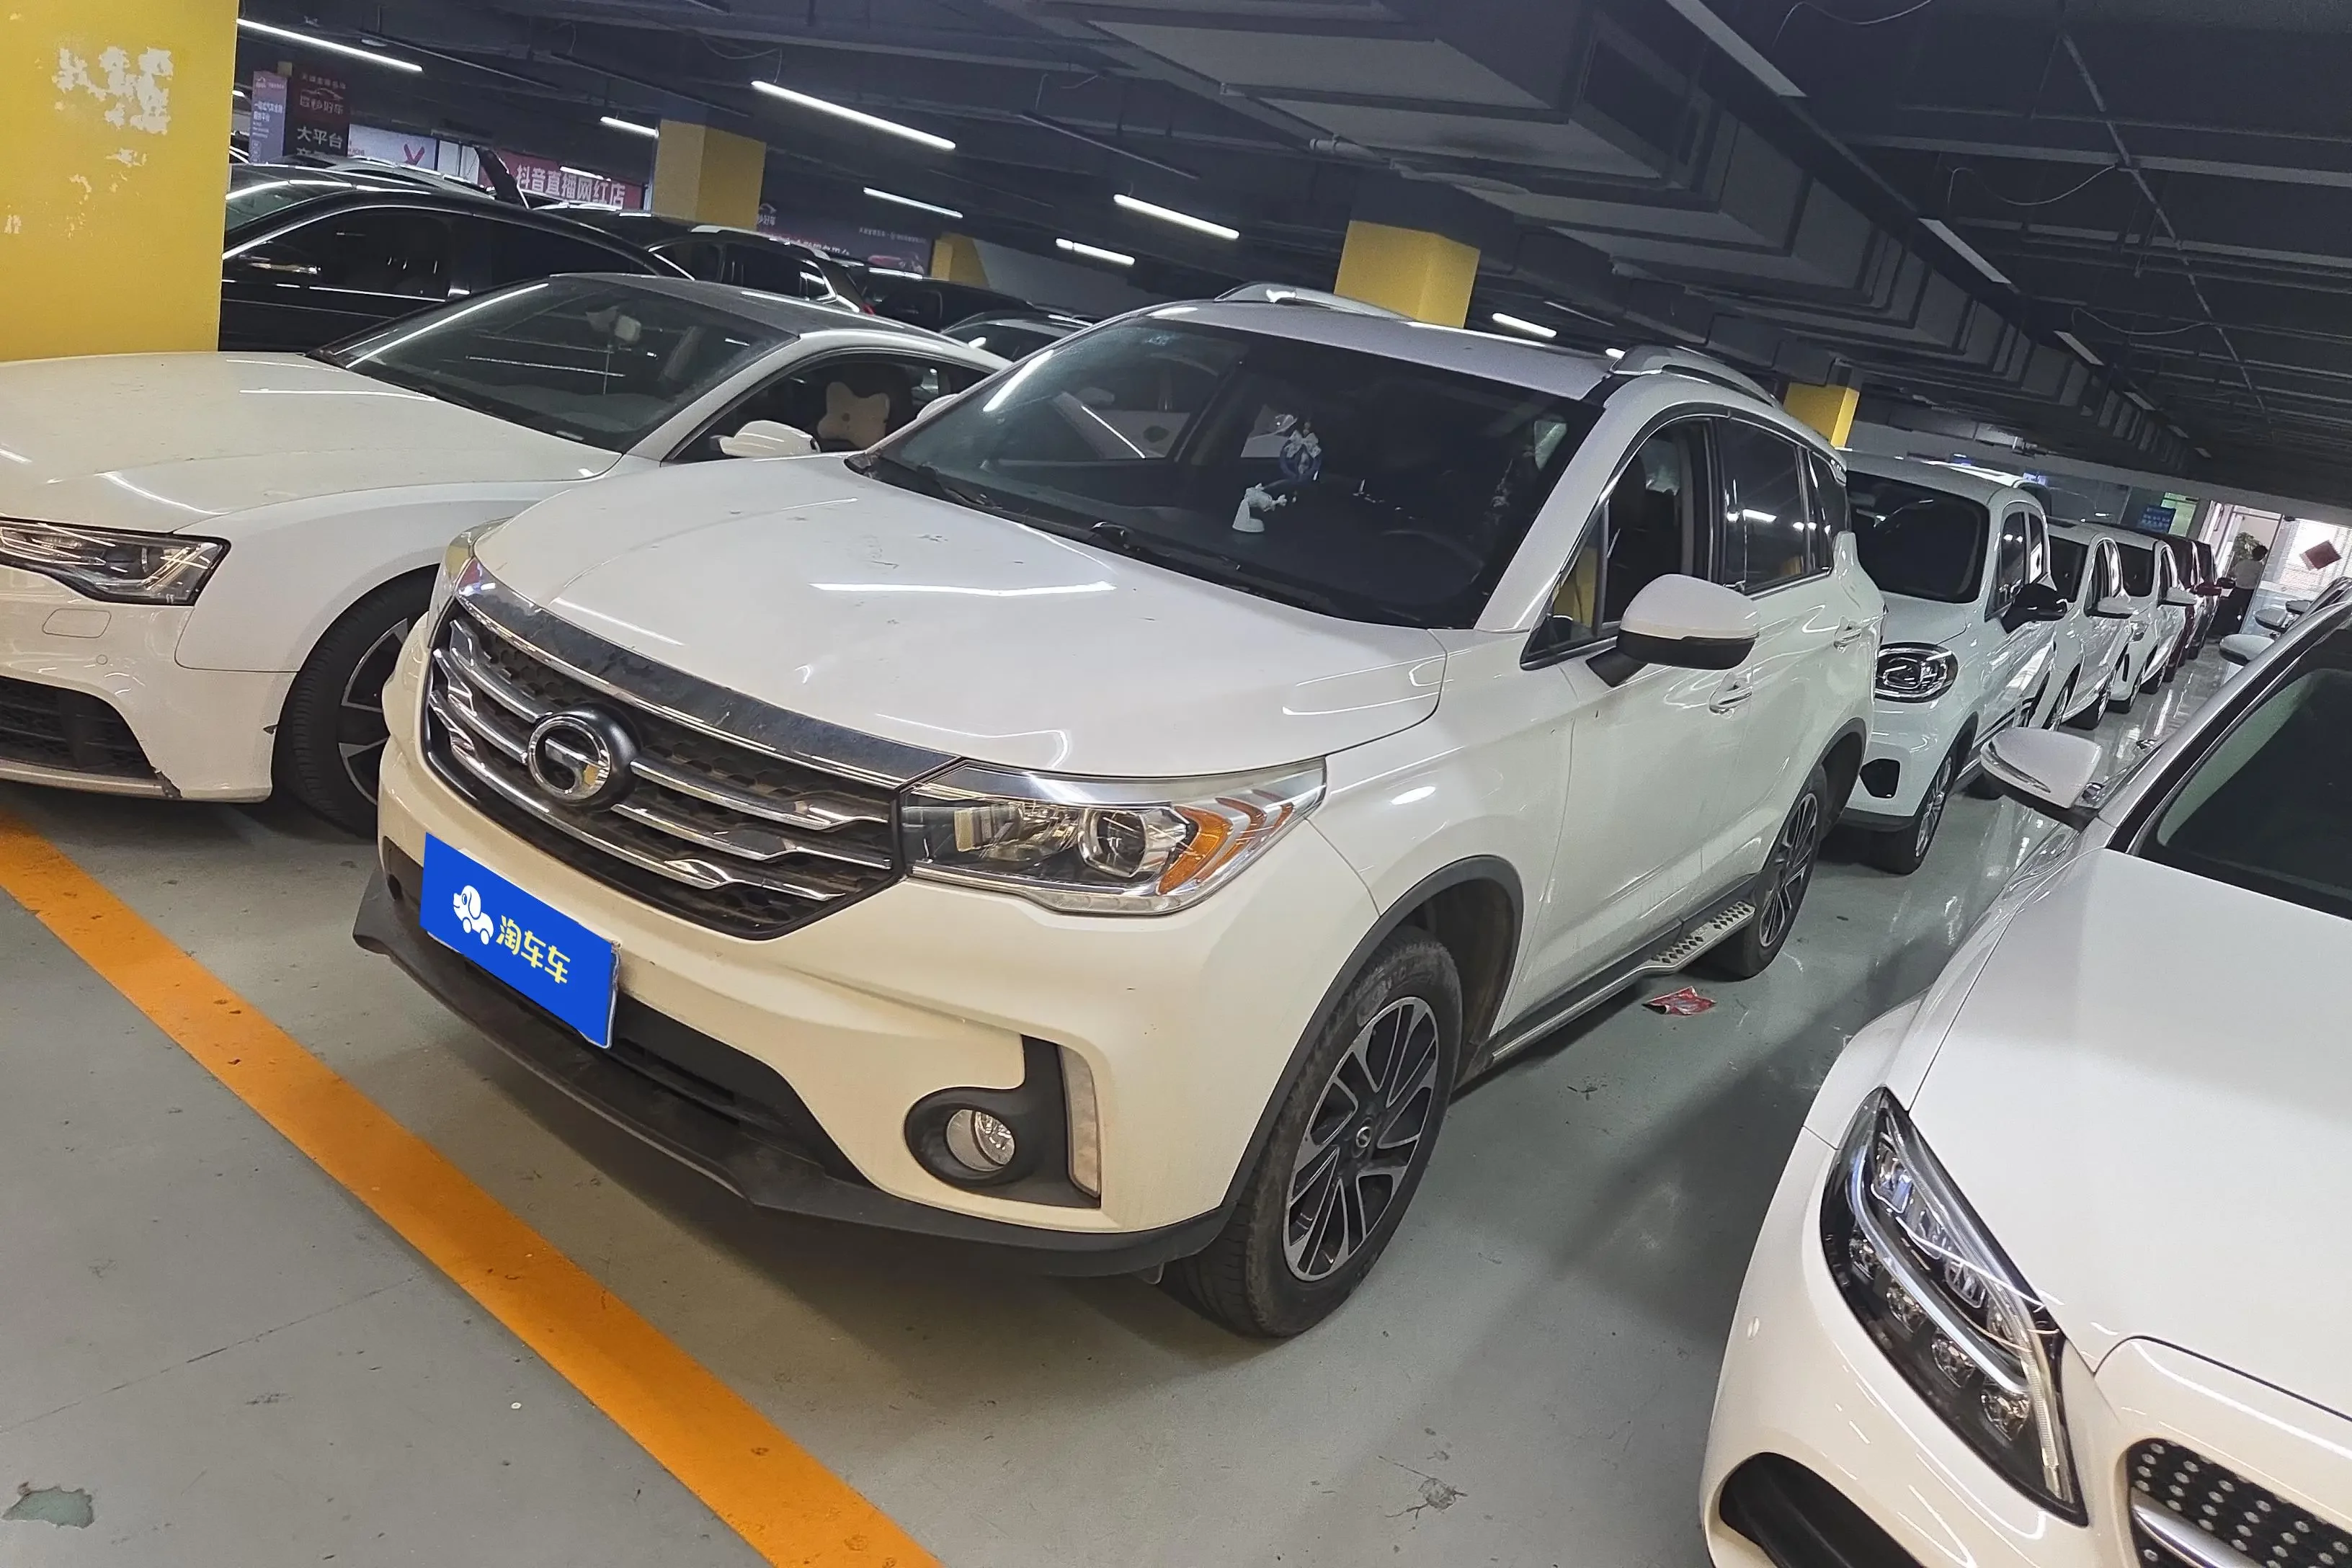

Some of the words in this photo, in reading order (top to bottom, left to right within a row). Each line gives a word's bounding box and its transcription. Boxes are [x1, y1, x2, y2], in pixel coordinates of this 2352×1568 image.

[297, 125, 343, 149] 大平台
[516, 164, 626, 208] 抖音直播网红店
